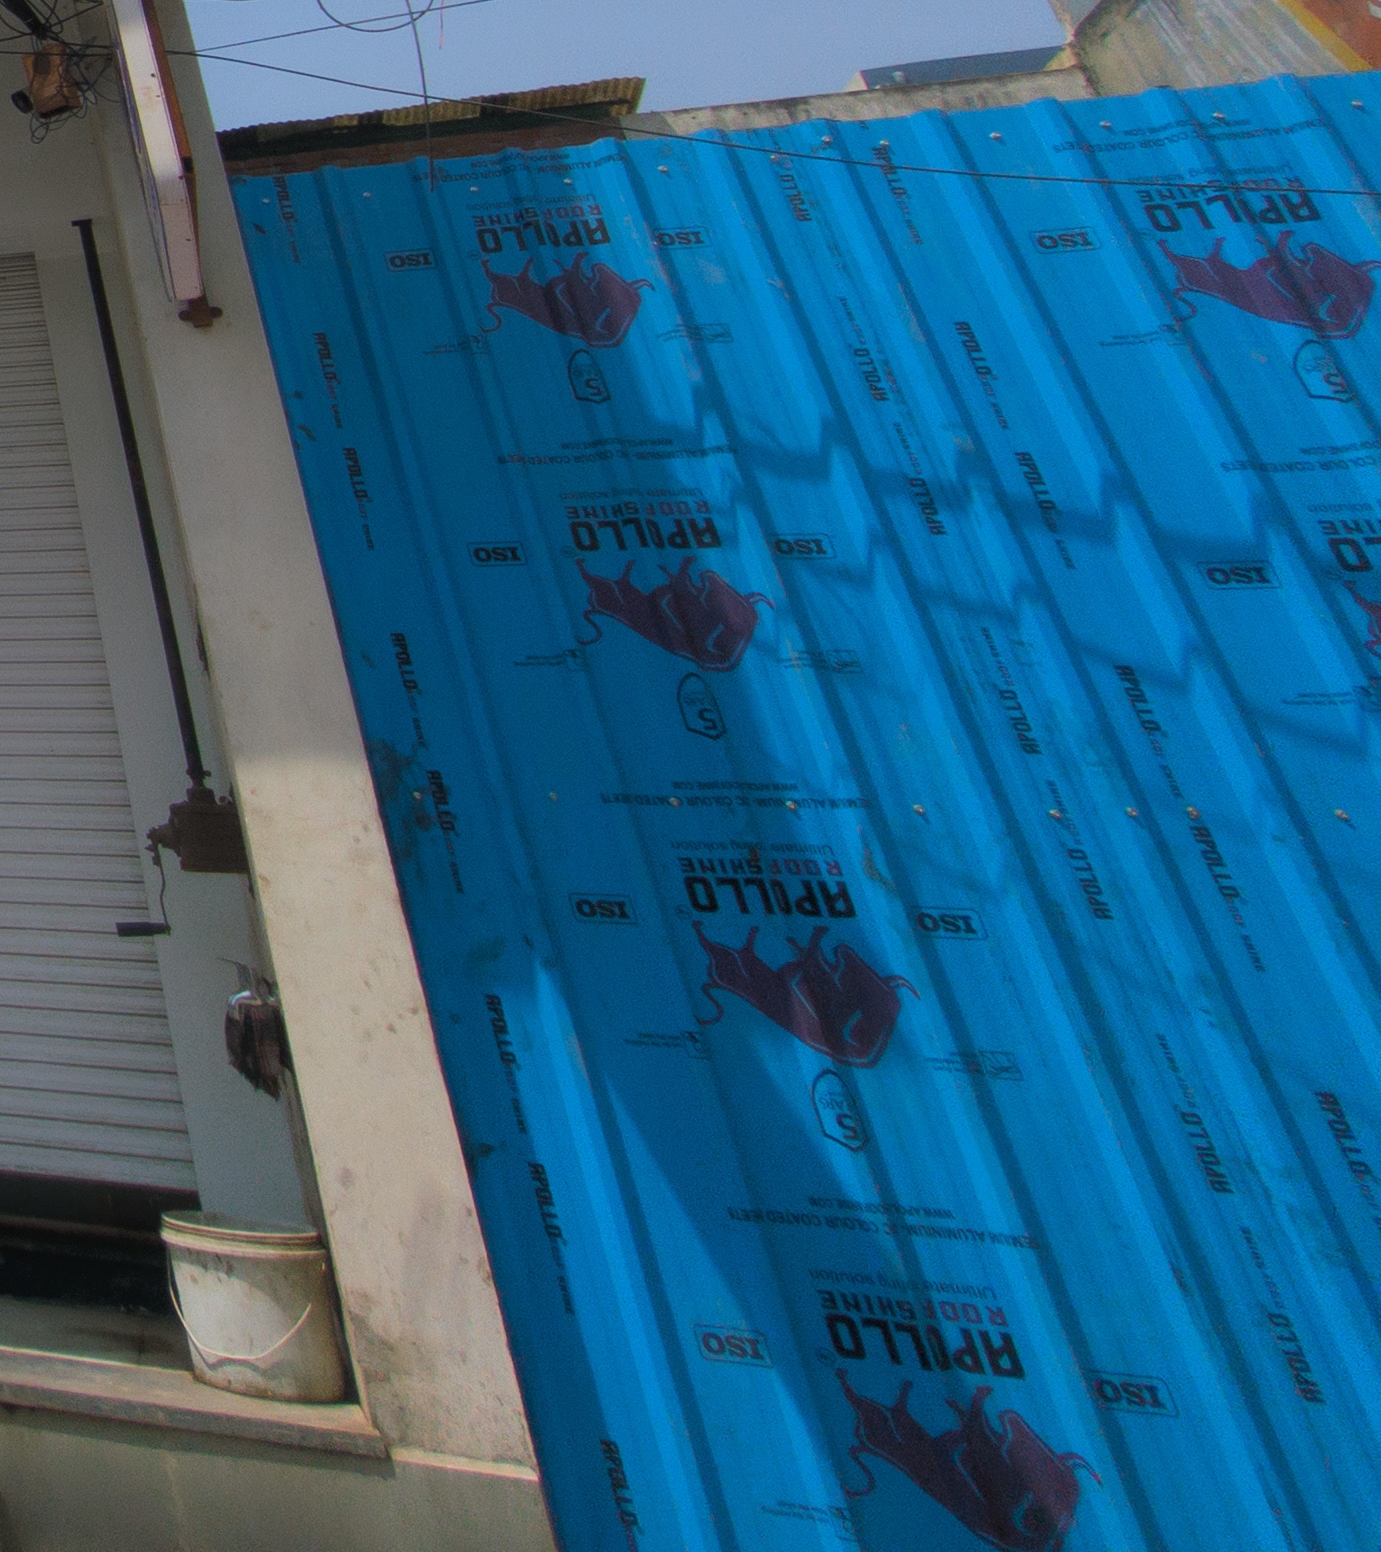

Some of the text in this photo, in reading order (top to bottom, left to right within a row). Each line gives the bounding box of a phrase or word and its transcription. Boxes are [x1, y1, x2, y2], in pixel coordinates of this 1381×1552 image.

[777, 173, 812, 221] APOLLO
[476, 218, 612, 254] APOLLO
[656, 229, 703, 246] ISO
[1038, 230, 1093, 250] ISO
[388, 251, 433, 269] ISO
[312, 333, 338, 380] APOLLO
[953, 321, 992, 375] APOLLO
[852, 347, 889, 401] APOLLO
[342, 448, 368, 498] APOLLO
[1014, 451, 1055, 509] APOLLO
[908, 477, 947, 535] APOLLO
[473, 546, 521, 563] ISO
[569, 517, 722, 552] APOLLO
[776, 537, 827, 557] ISO
[1206, 564, 1272, 587] ISO
[389, 633, 418, 689] APOLLO
[699, 709, 719, 731] 5
[1114, 664, 1161, 731] APOLLO
[996, 688, 1042, 755] APOLLO
[1066, 848, 1113, 921] APOLLO
[1189, 824, 1239, 898] APOLLO
[576, 900, 633, 920] ISO
[684, 876, 857, 919] APOLLO
[917, 913, 978, 936] ISO
[484, 995, 516, 1063] APOLLO
[837, 1113, 860, 1141] 5
[1315, 1090, 1369, 1173] APOLLO
[1179, 1111, 1234, 1195] APOLLO
[527, 1162, 561, 1237] APOLLO
[765, 1209, 822, 1227] COATED
[703, 1330, 766, 1361] ISO
[825, 1313, 1026, 1381] APOLLO
[1267, 1312, 1324, 1404] APOLLO
[1095, 1378, 1167, 1410] ISO
